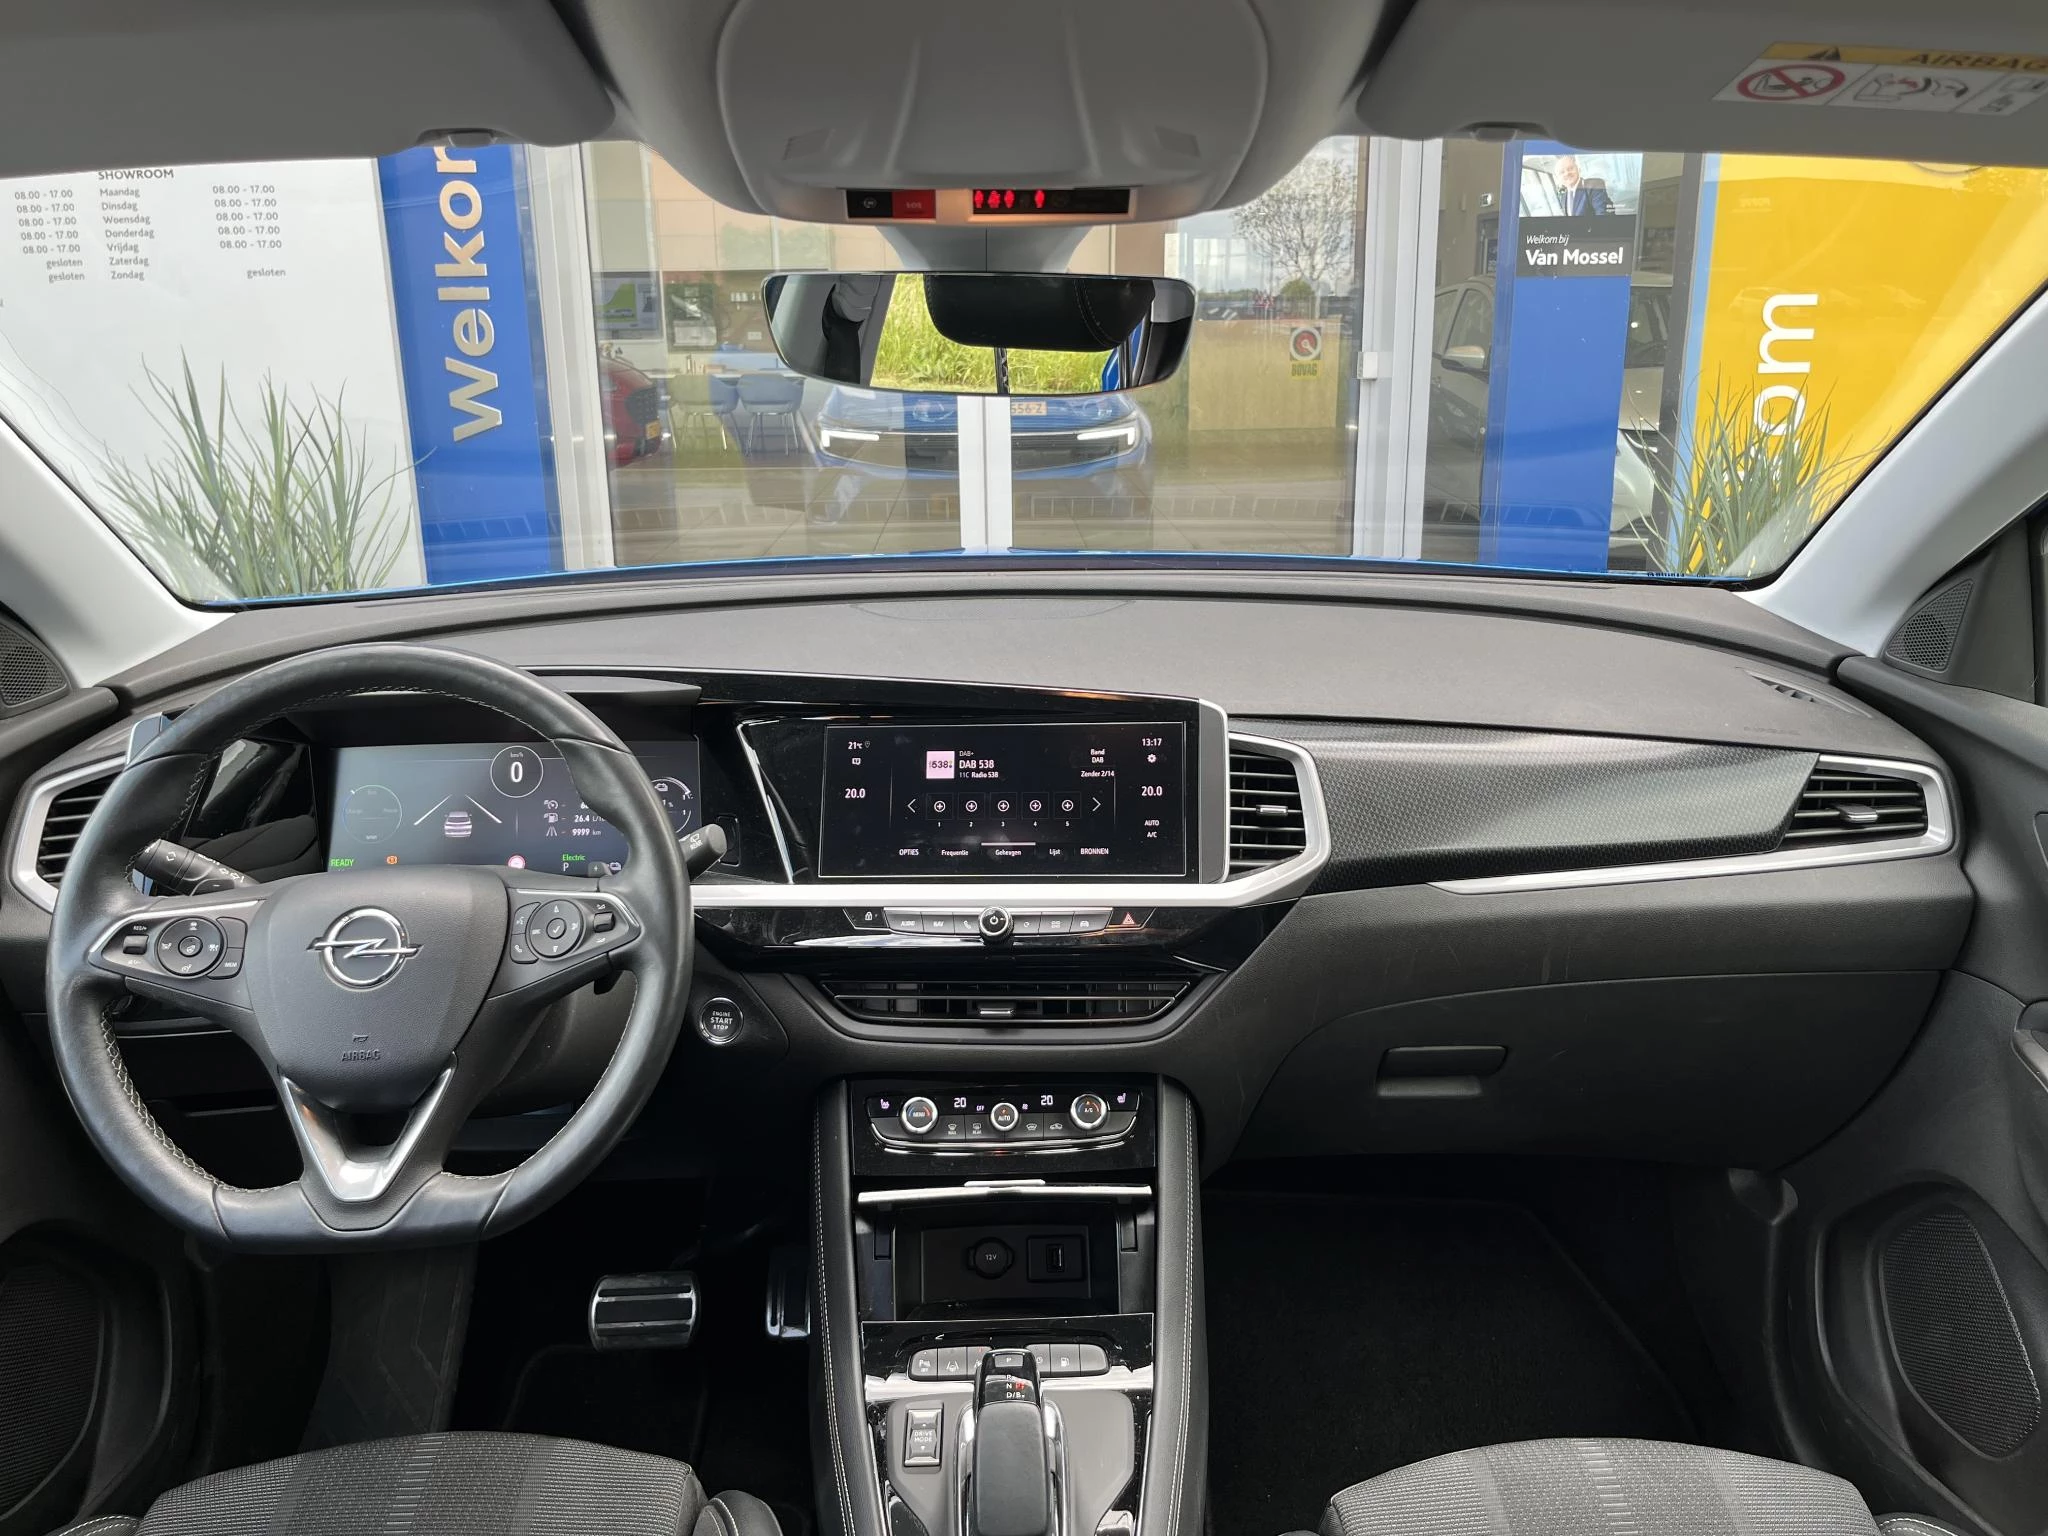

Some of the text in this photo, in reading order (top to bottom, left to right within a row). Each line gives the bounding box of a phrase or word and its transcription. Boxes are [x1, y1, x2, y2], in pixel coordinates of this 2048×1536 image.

[98, 169, 174, 180] SHOWROOM
[15, 191, 40, 199] 08.00
[49, 189, 73, 198] 17.00
[99, 188, 140, 198] Maandag
[212, 185, 240, 194] 08.00
[250, 185, 275, 193] 17.00
[101, 201, 138, 212] Dinsdag
[214, 199, 242, 207] 08.00
[251, 198, 277, 207] 17.00
[17, 205, 42, 213] 08.00
[52, 203, 75, 212] 17.00
[103, 215, 151, 225] Woensdag
[216, 213, 243, 221] 08.00
[253, 212, 278, 221] 17.00
[19, 218, 44, 227] 08.00
[53, 217, 77, 226] 17.00
[21, 232, 46, 240] 08.00
[55, 230, 79, 239] 17.00
[105, 228, 155, 239] Donderdag
[218, 226, 245, 235] 08.00
[255, 226, 280, 234] 17.00
[219, 240, 247, 249] 08.00
[257, 239, 282, 248] 17.00
[1526, 234, 1569, 246] Welkom bij
[23, 246, 48, 254] 08.00
[57, 244, 81, 253] 17.00
[107, 243, 139, 254] Vrijdag
[109, 256, 149, 267] Zaterdag
[1525, 247, 1624, 266] Van Mossel
[46, 259, 83, 269] gesloten
[49, 272, 85, 284] gesloten
[110, 270, 145, 281] Zondag
[247, 268, 286, 279] gesloten
[1291, 363, 1317, 377] BOVAG
[1141, 738, 1162, 746] 13:17
[959, 759, 995, 769] DAB 538
[510, 761, 523, 783] 0
[845, 788, 866, 799] 20.0
[1141, 785, 1163, 796] 20.0
[574, 814, 590, 823] 26.4
[572, 828, 590, 836] 9999
[899, 848, 919, 856] OPTIES
[941, 849, 969, 857] Frequentie
[1049, 848, 1061, 856] Lijst
[331, 859, 354, 867] READY
[563, 862, 570, 872] P
[342, 1049, 381, 1061] AIRBAG
[953, 1097, 967, 1108] 20
[1040, 1095, 1053, 1106] 20
